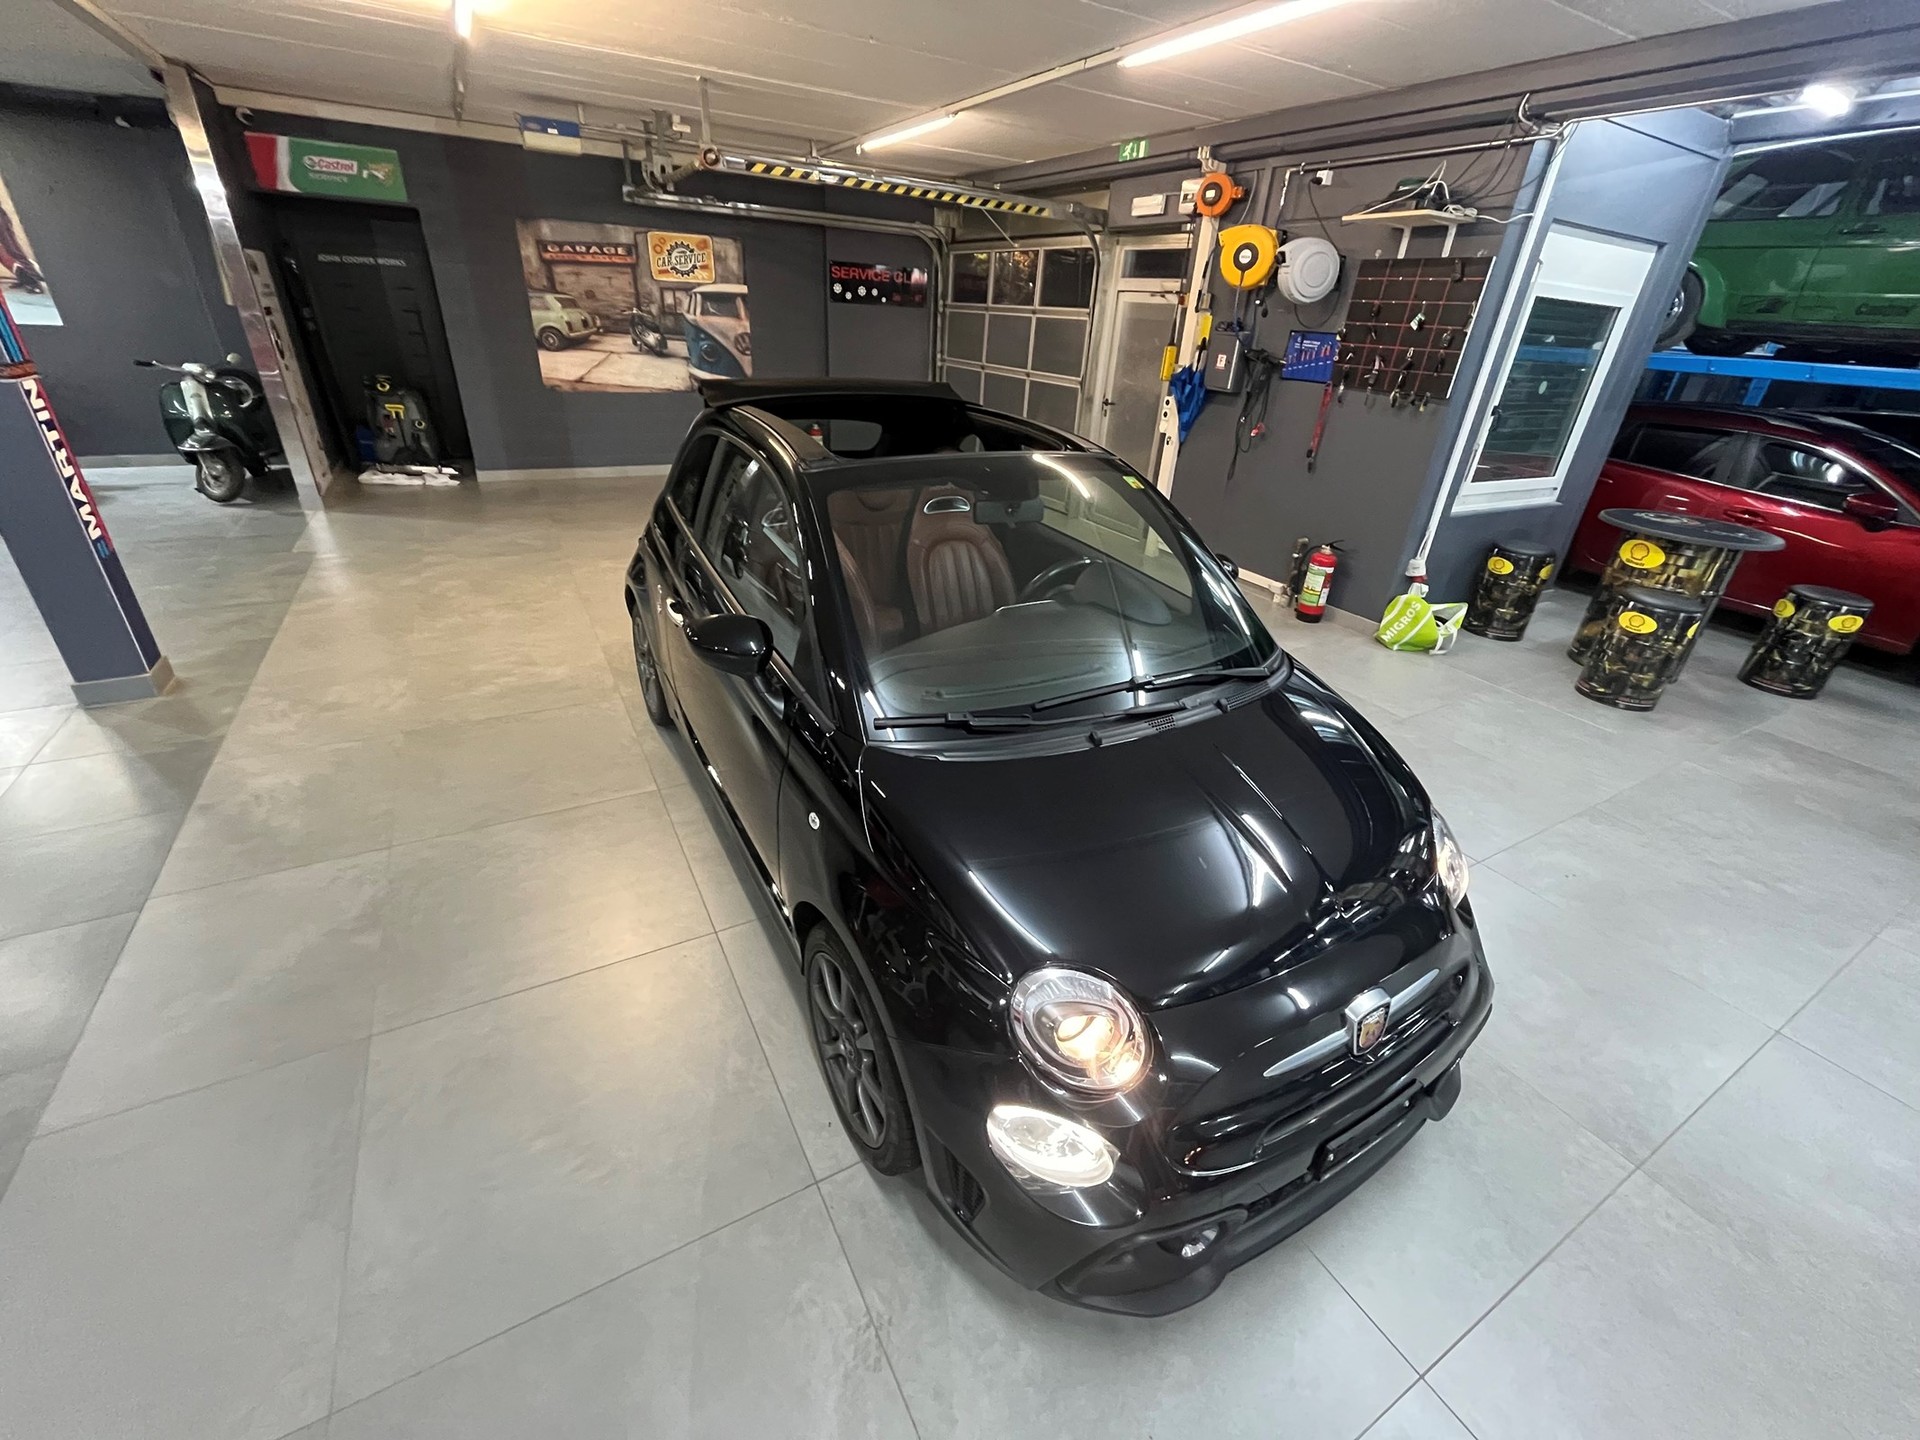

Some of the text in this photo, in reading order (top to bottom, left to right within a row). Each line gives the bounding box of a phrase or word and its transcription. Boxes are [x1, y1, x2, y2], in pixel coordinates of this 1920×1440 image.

[317, 159, 355, 172] Castrol
[546, 244, 629, 256] GARAGE
[317, 254, 406, 267] JOHN COOPER WORKS
[656, 252, 706, 268] CAR SERVICE
[831, 265, 891, 282] SERVICE
[1381, 600, 1422, 643] MIGROS
